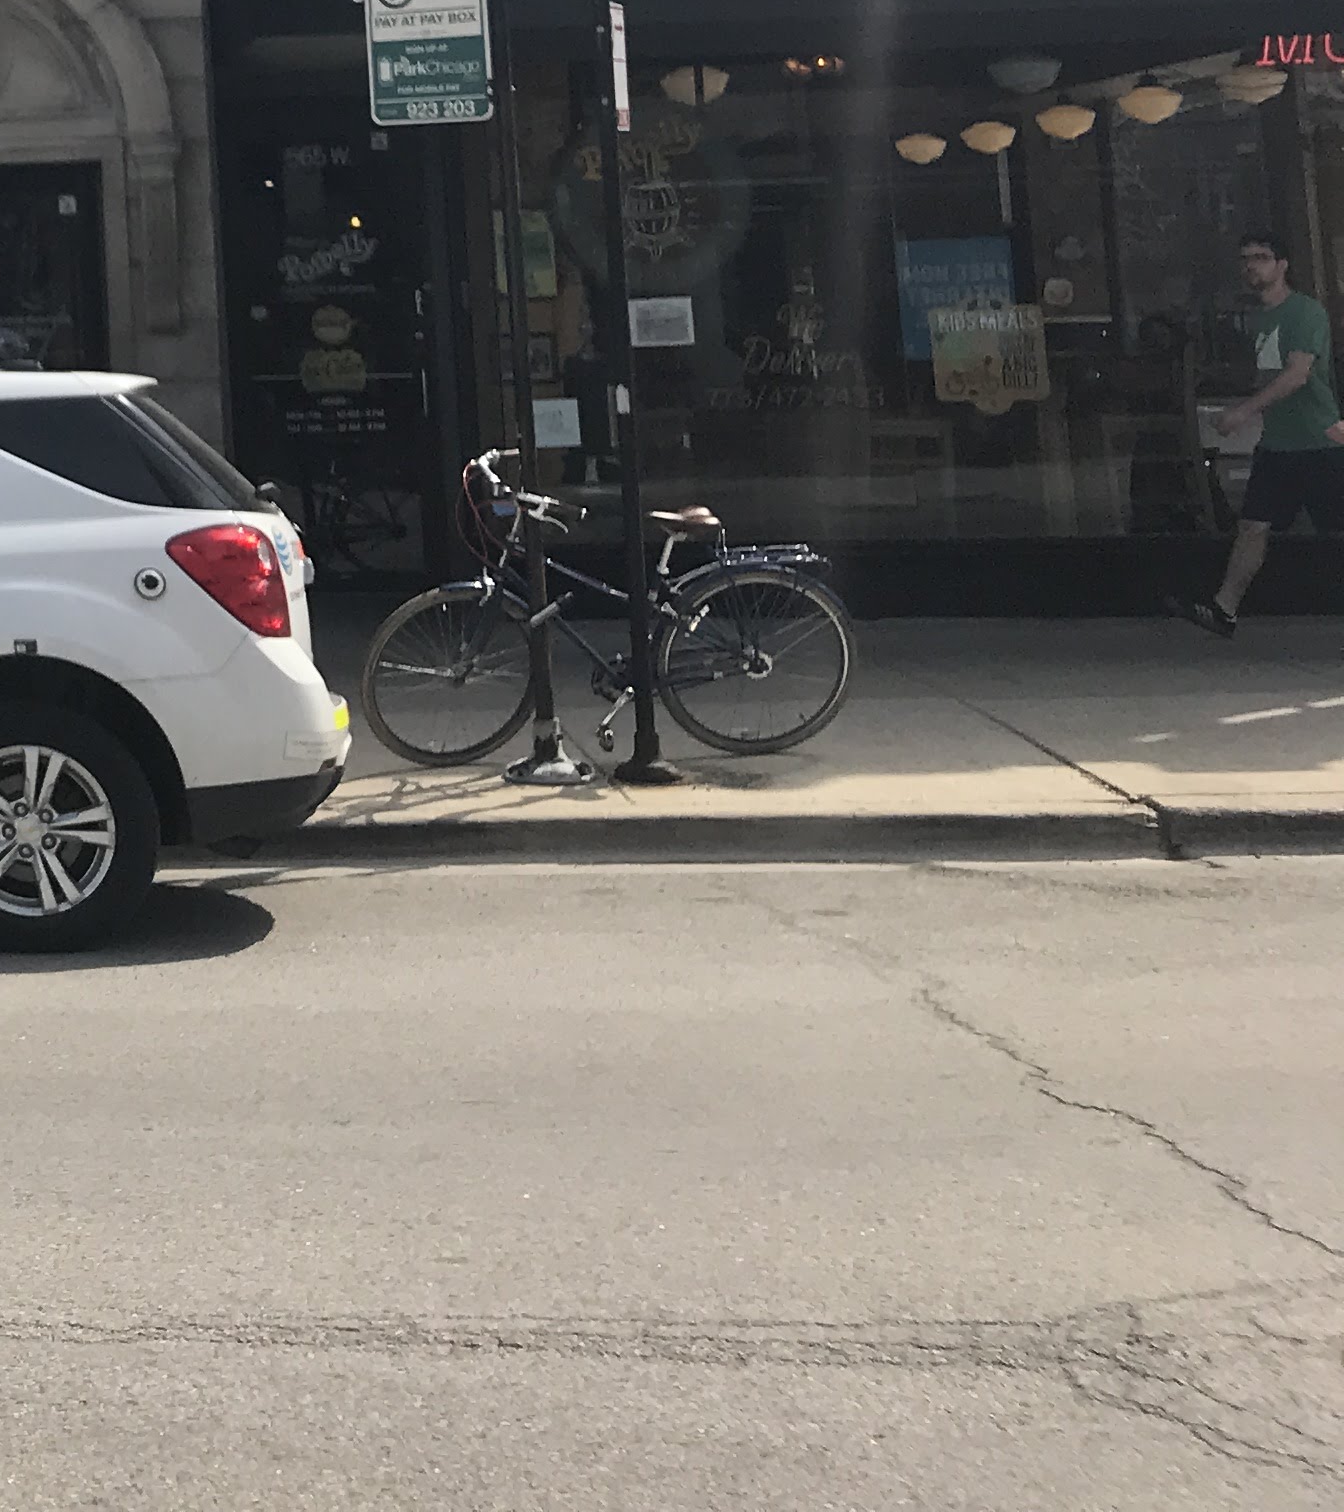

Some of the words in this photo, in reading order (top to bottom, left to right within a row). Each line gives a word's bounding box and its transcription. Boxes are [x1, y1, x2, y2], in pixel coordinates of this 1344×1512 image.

[375, 15, 400, 29] PAY
[401, 15, 418, 26] AT
[421, 13, 444, 27] PAY
[448, 11, 477, 24] BOX
